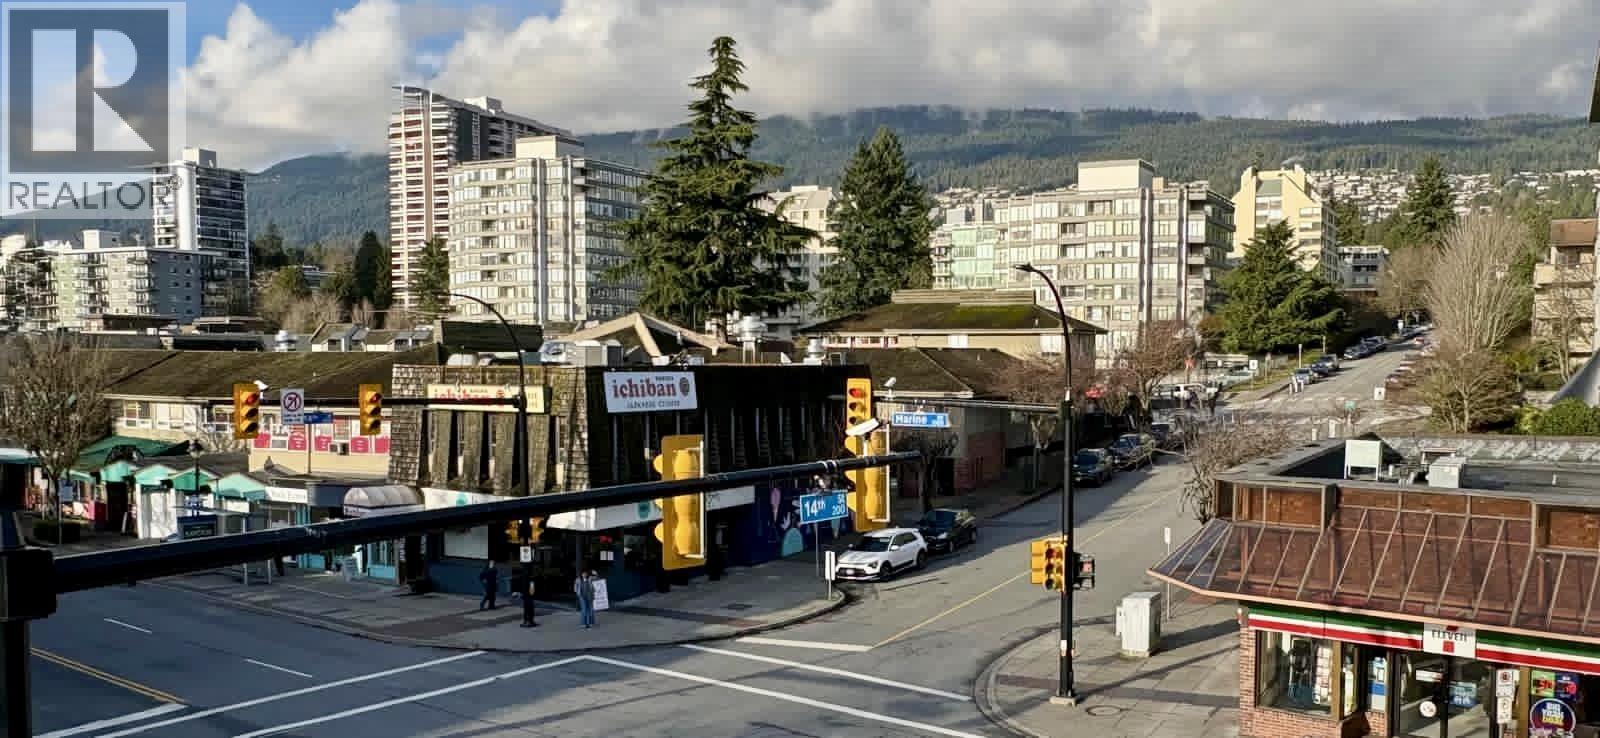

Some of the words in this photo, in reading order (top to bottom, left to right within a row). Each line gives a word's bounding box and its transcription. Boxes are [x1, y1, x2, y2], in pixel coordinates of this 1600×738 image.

[612, 377, 677, 399] ichiban
[895, 414, 928, 425] Marine
[804, 498, 825, 517] 14th
[832, 503, 846, 516] 200
